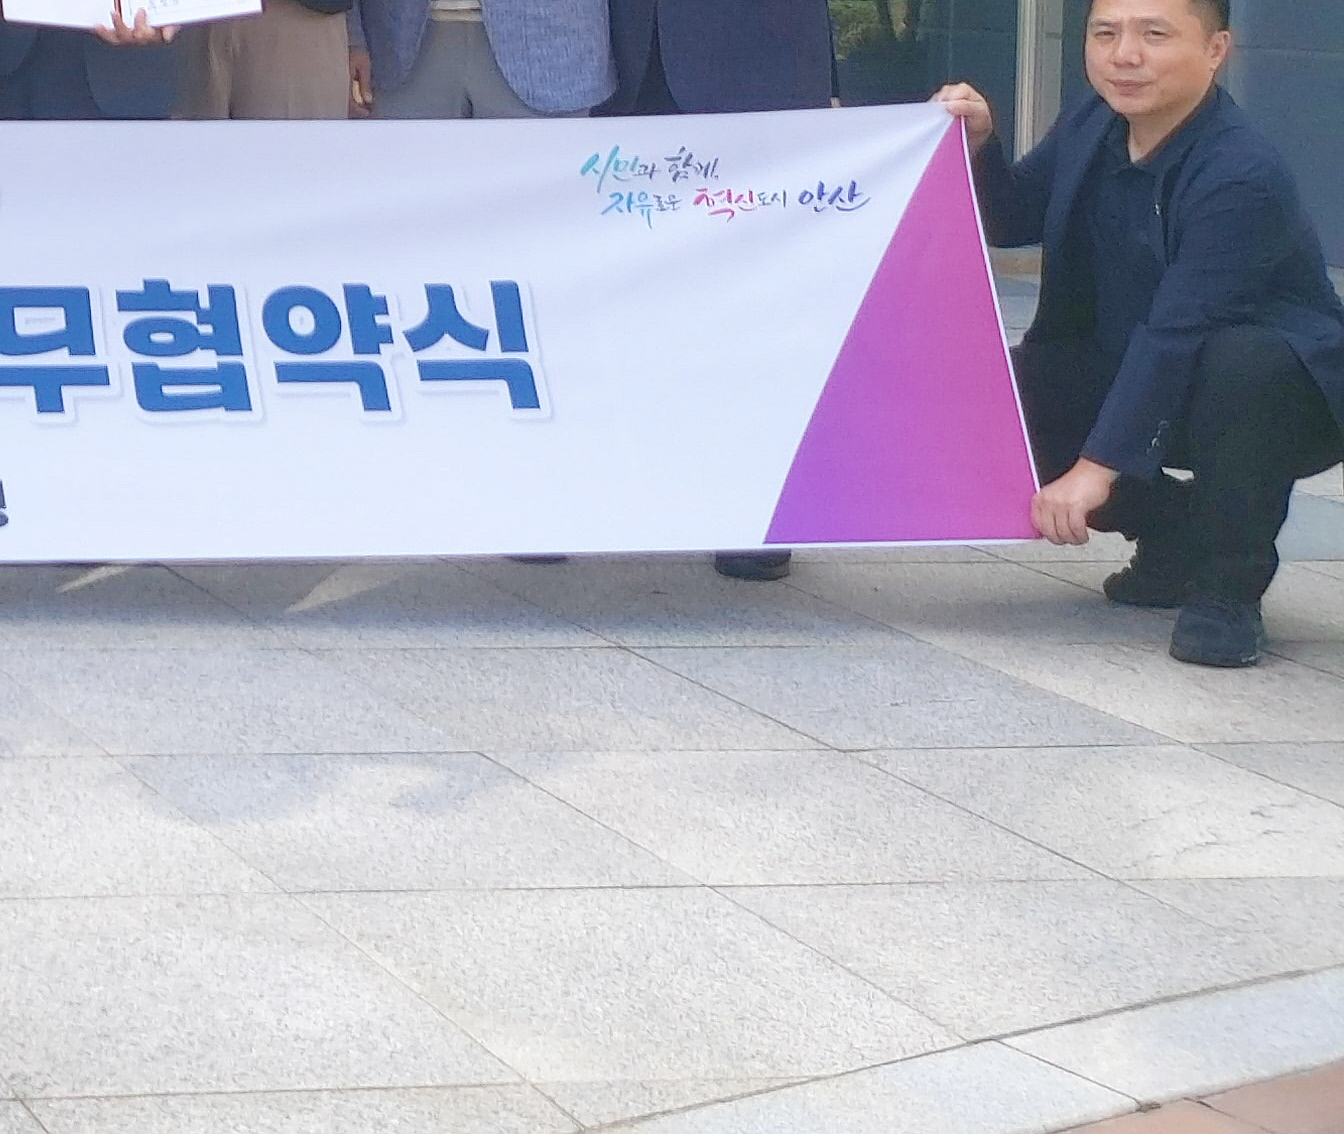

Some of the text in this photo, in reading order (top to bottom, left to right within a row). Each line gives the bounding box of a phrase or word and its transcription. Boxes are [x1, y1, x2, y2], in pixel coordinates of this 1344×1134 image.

[579, 145, 662, 193] 시민과
[600, 179, 872, 229] 자유로운 혁신도시 안산
